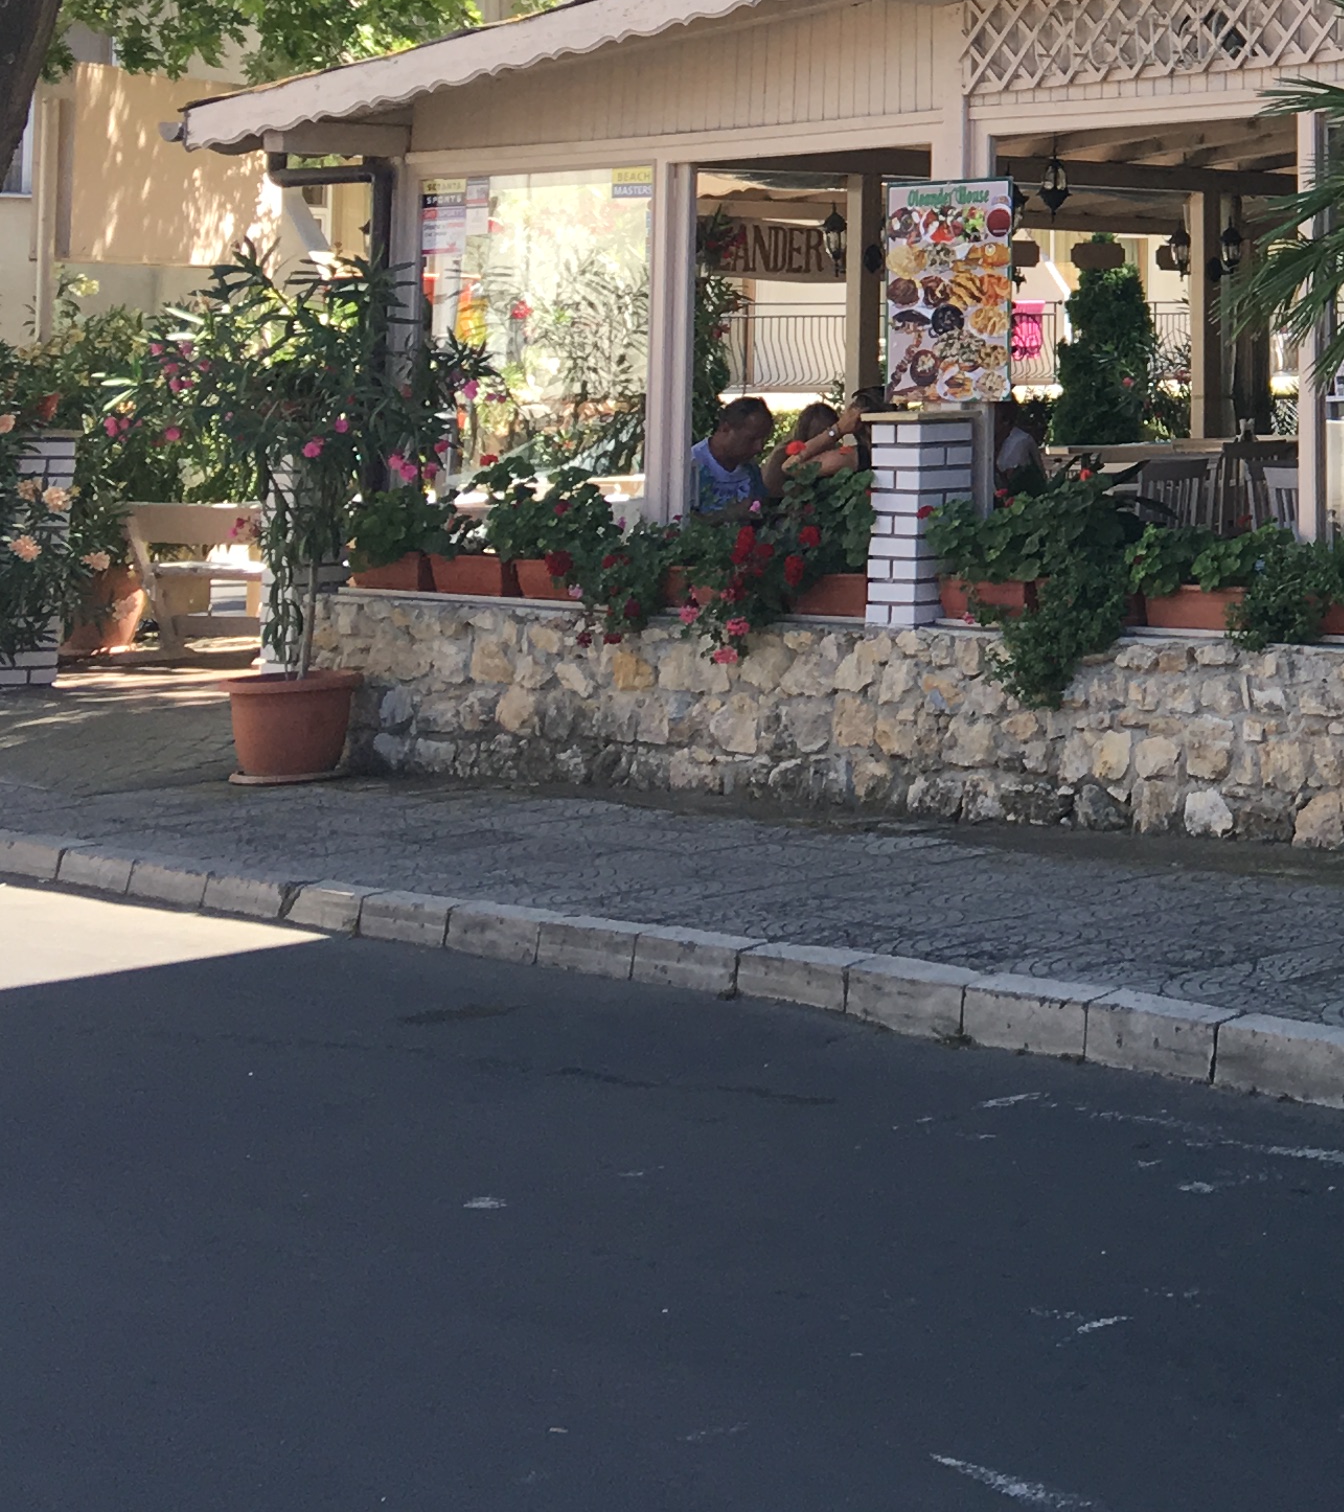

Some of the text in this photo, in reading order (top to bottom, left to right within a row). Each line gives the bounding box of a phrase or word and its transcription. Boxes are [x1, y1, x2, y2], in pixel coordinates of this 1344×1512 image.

[617, 172, 650, 182] BEACH
[614, 185, 652, 196] MASTERS
[717, 223, 824, 274] ANDER
